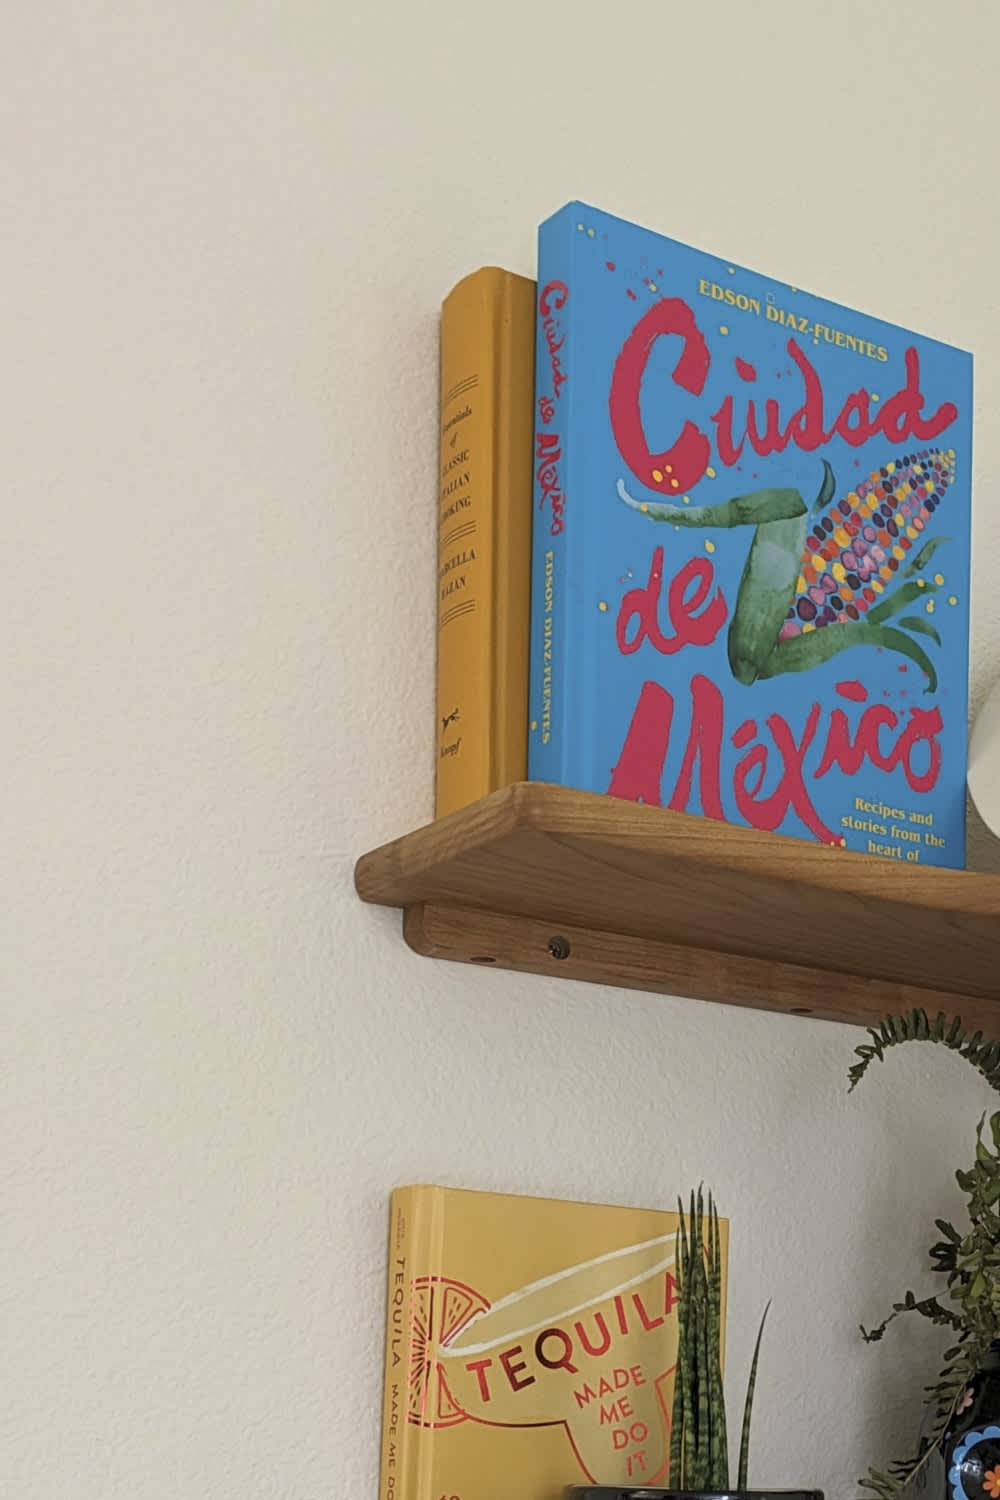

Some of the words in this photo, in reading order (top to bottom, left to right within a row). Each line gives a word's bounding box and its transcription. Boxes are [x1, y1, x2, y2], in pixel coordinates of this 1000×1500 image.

[539, 280, 569, 399] Ciudad
[698, 279, 760, 316] EDSON
[765, 303, 889, 362] DIAZ-FUENTES
[609, 297, 958, 495] Ciudad
[545, 551, 553, 613] EDSON
[616, 545, 728, 655] de
[542, 617, 552, 744] DIAZ-FUENTES
[607, 674, 943, 848] México
[840, 816, 887, 835] stories
[891, 825, 921, 842] from
[925, 833, 945, 848] the
[855, 797, 906, 820] Recipes
[909, 811, 933, 826] and
[868, 840, 902, 858] heart
[906, 849, 920, 862] of
[391, 1257, 406, 1368] TEQUILA
[466, 1271, 681, 1402] TEQUILA
[389, 1383, 399, 1437] MADE
[573, 1365, 646, 1409] MADE
[599, 1396, 634, 1425] ME
[387, 1445, 397, 1469] ME
[612, 1422, 648, 1449] DO
[626, 1451, 646, 1476] IT
